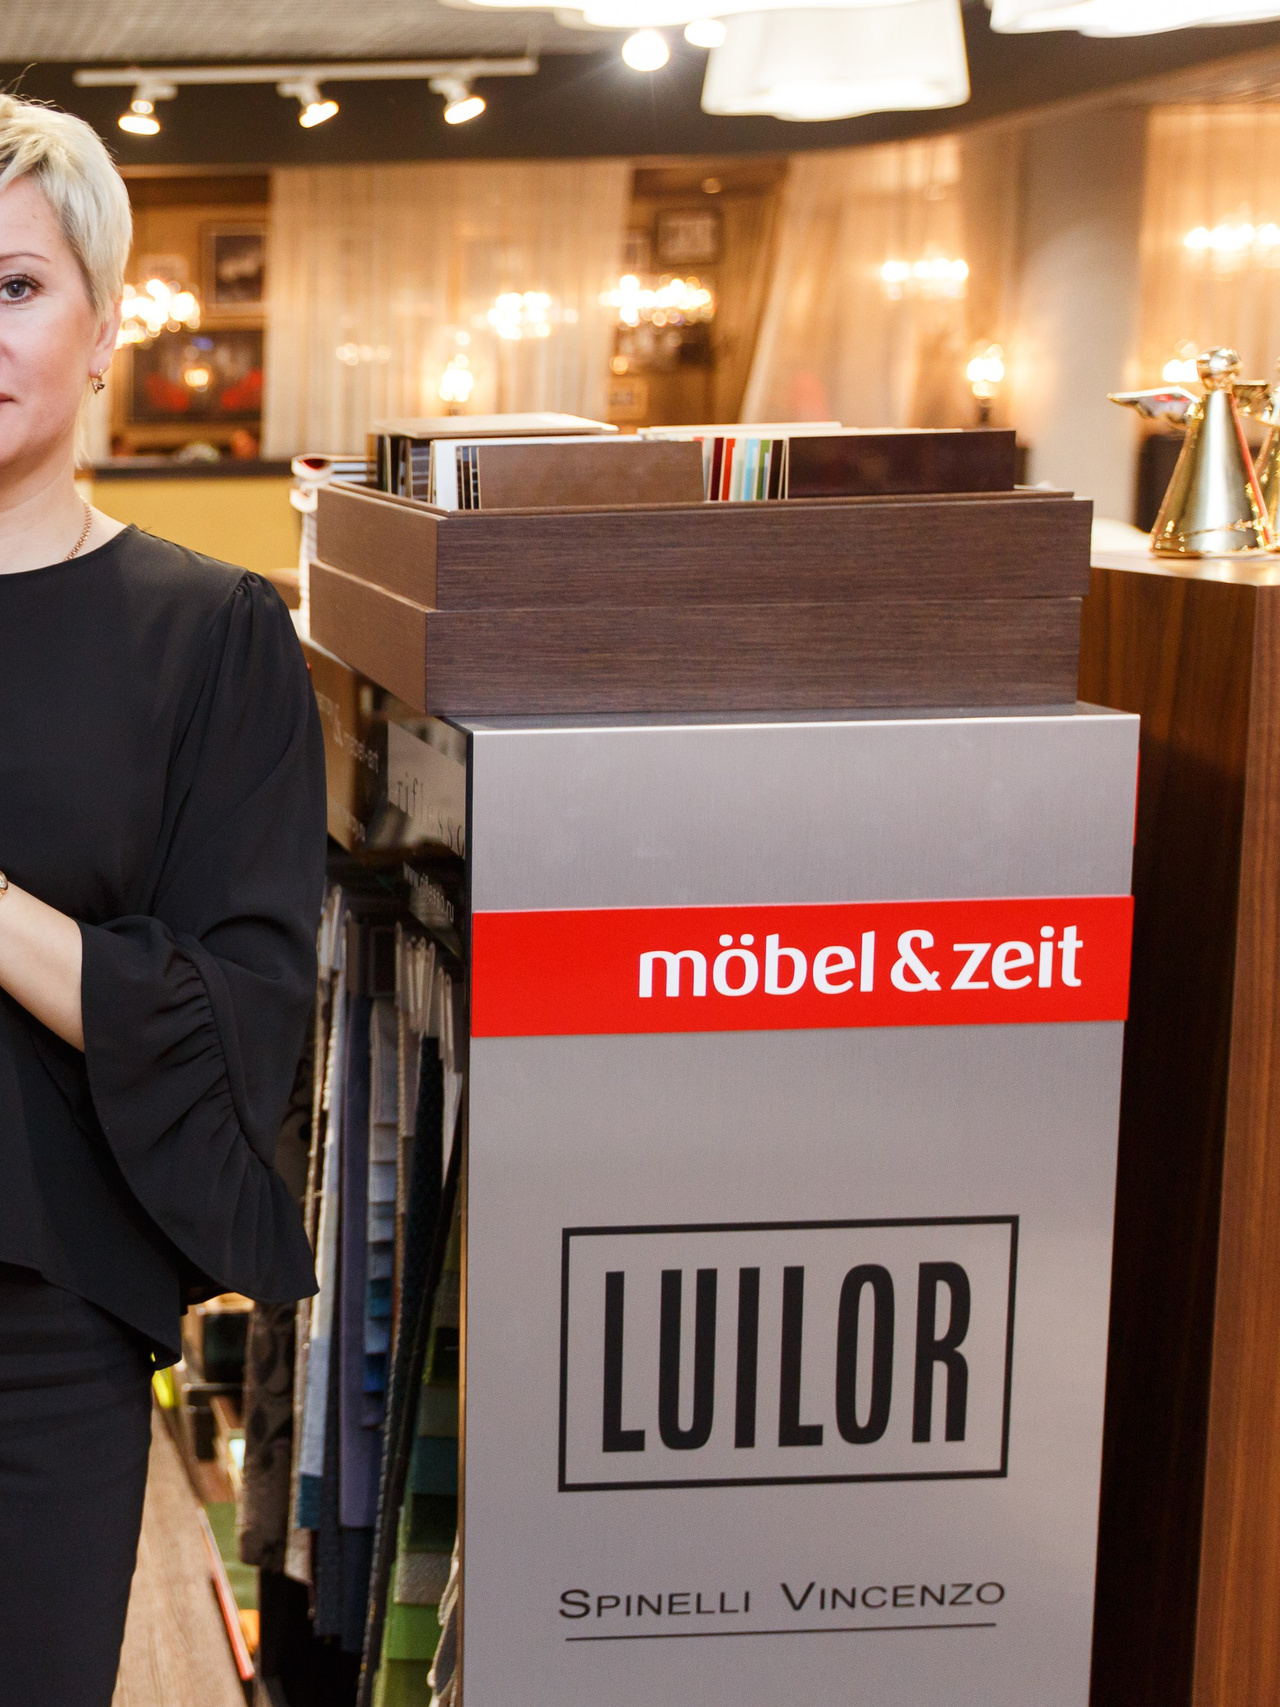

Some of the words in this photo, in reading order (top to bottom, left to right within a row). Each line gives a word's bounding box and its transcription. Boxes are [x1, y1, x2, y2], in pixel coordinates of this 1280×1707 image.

[639, 930, 875, 997] möbel
[891, 930, 941, 992] &
[951, 926, 1083, 989] zeit
[602, 1262, 970, 1453] LUILOR
